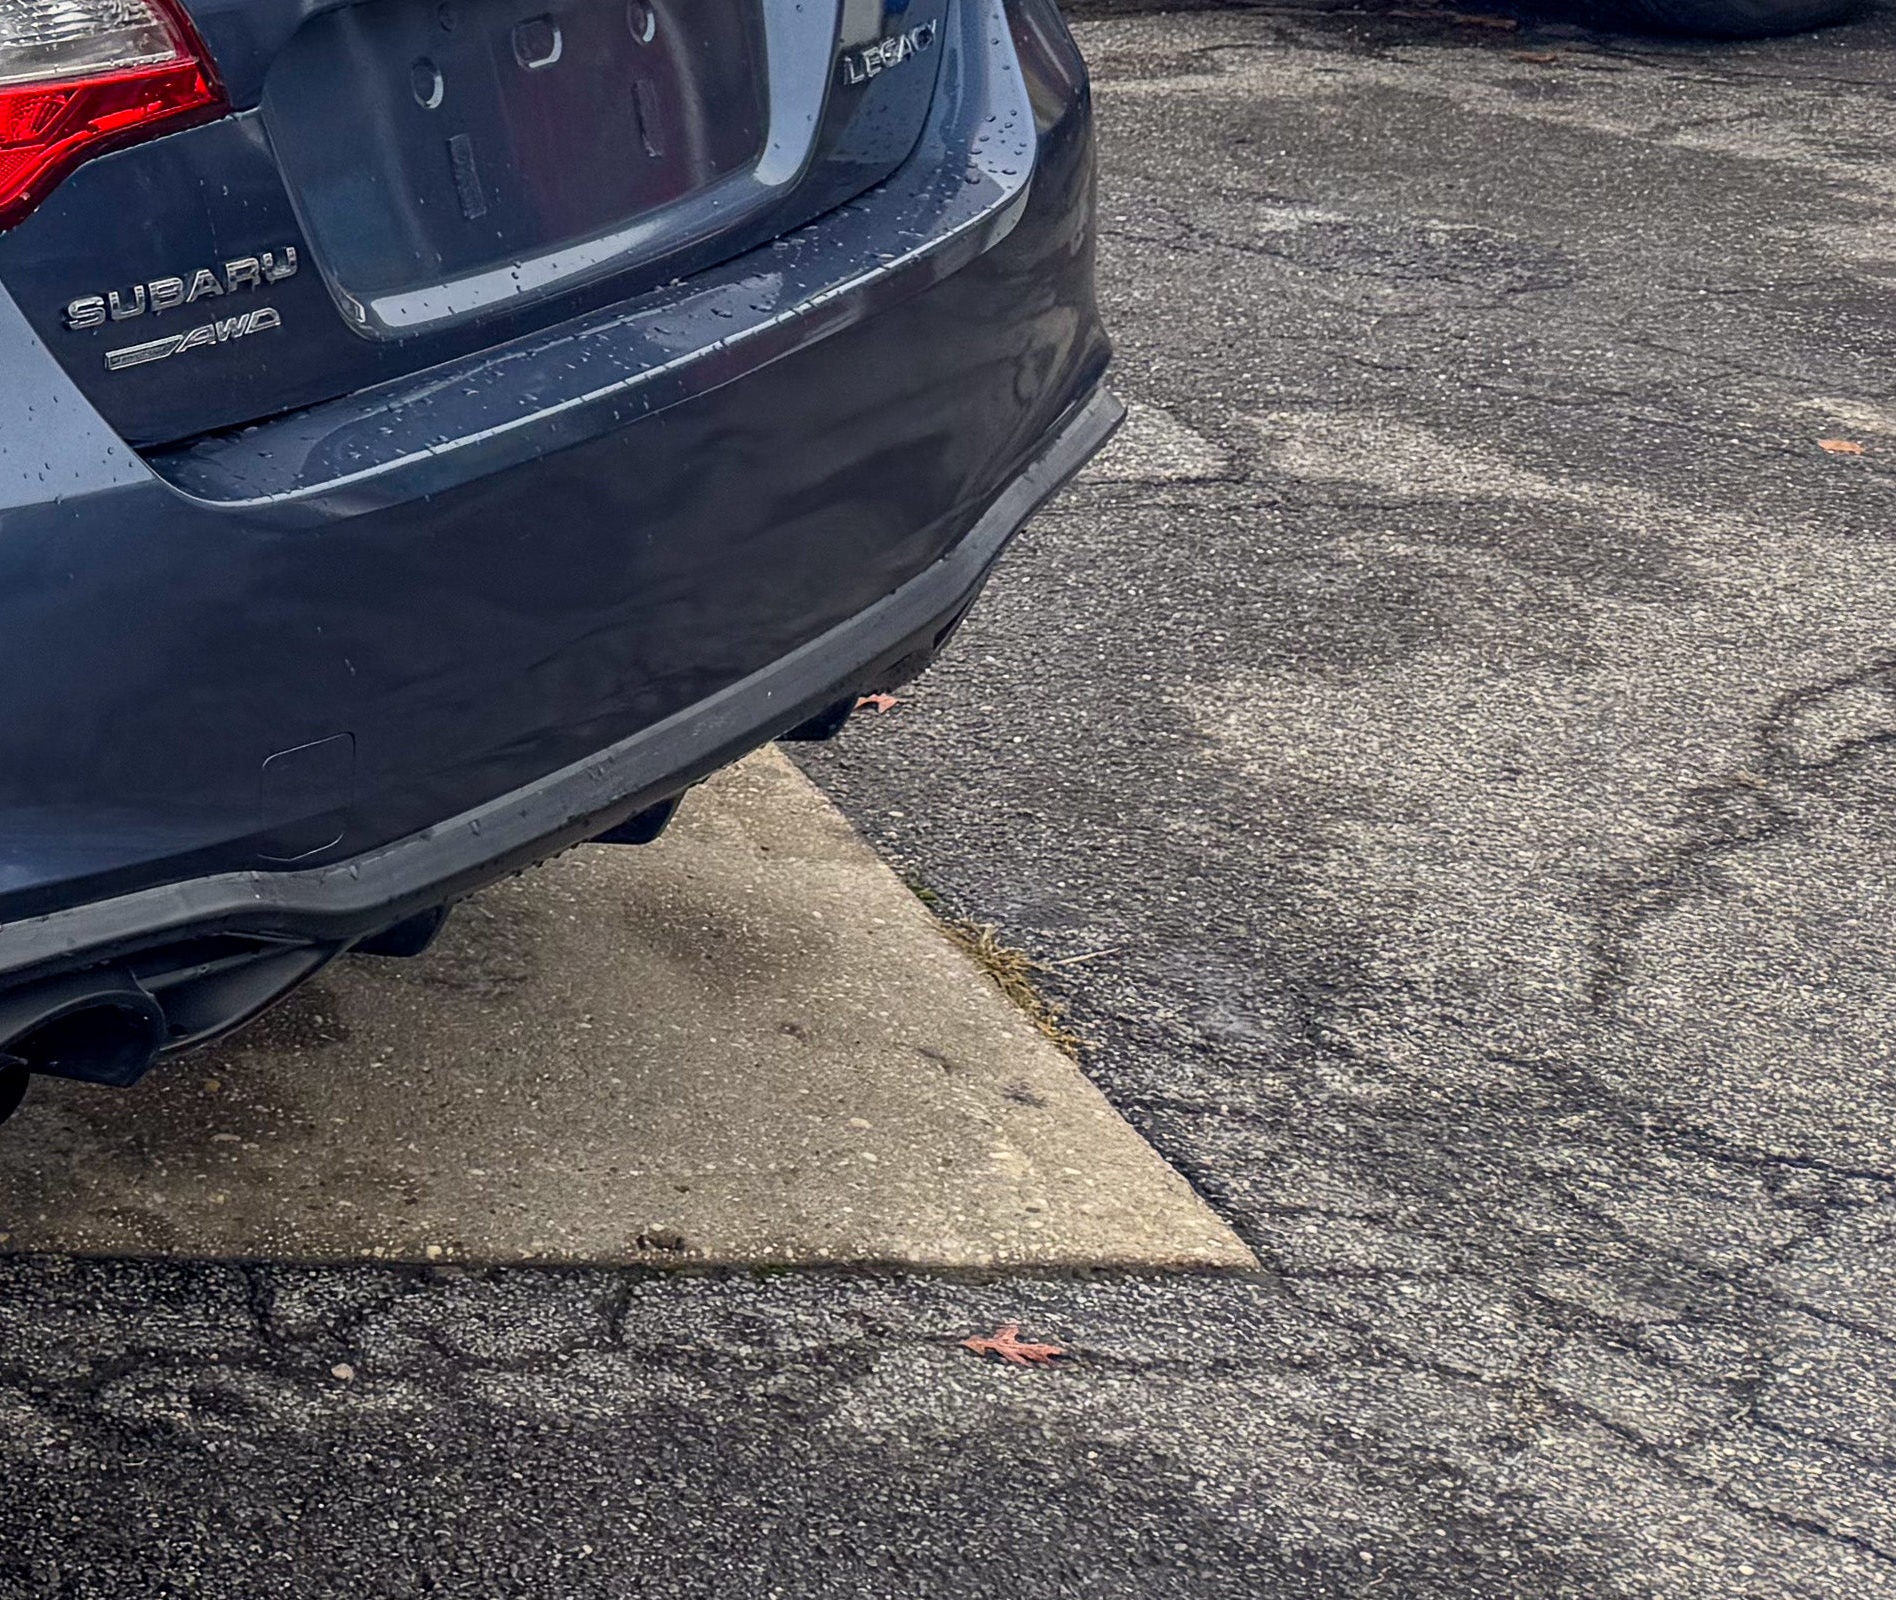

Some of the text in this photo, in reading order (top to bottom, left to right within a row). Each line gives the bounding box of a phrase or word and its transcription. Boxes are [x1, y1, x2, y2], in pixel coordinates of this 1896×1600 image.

[844, 19, 938, 85] LEGACY
[67, 246, 298, 330] SUBARU
[175, 307, 282, 354] AWD
